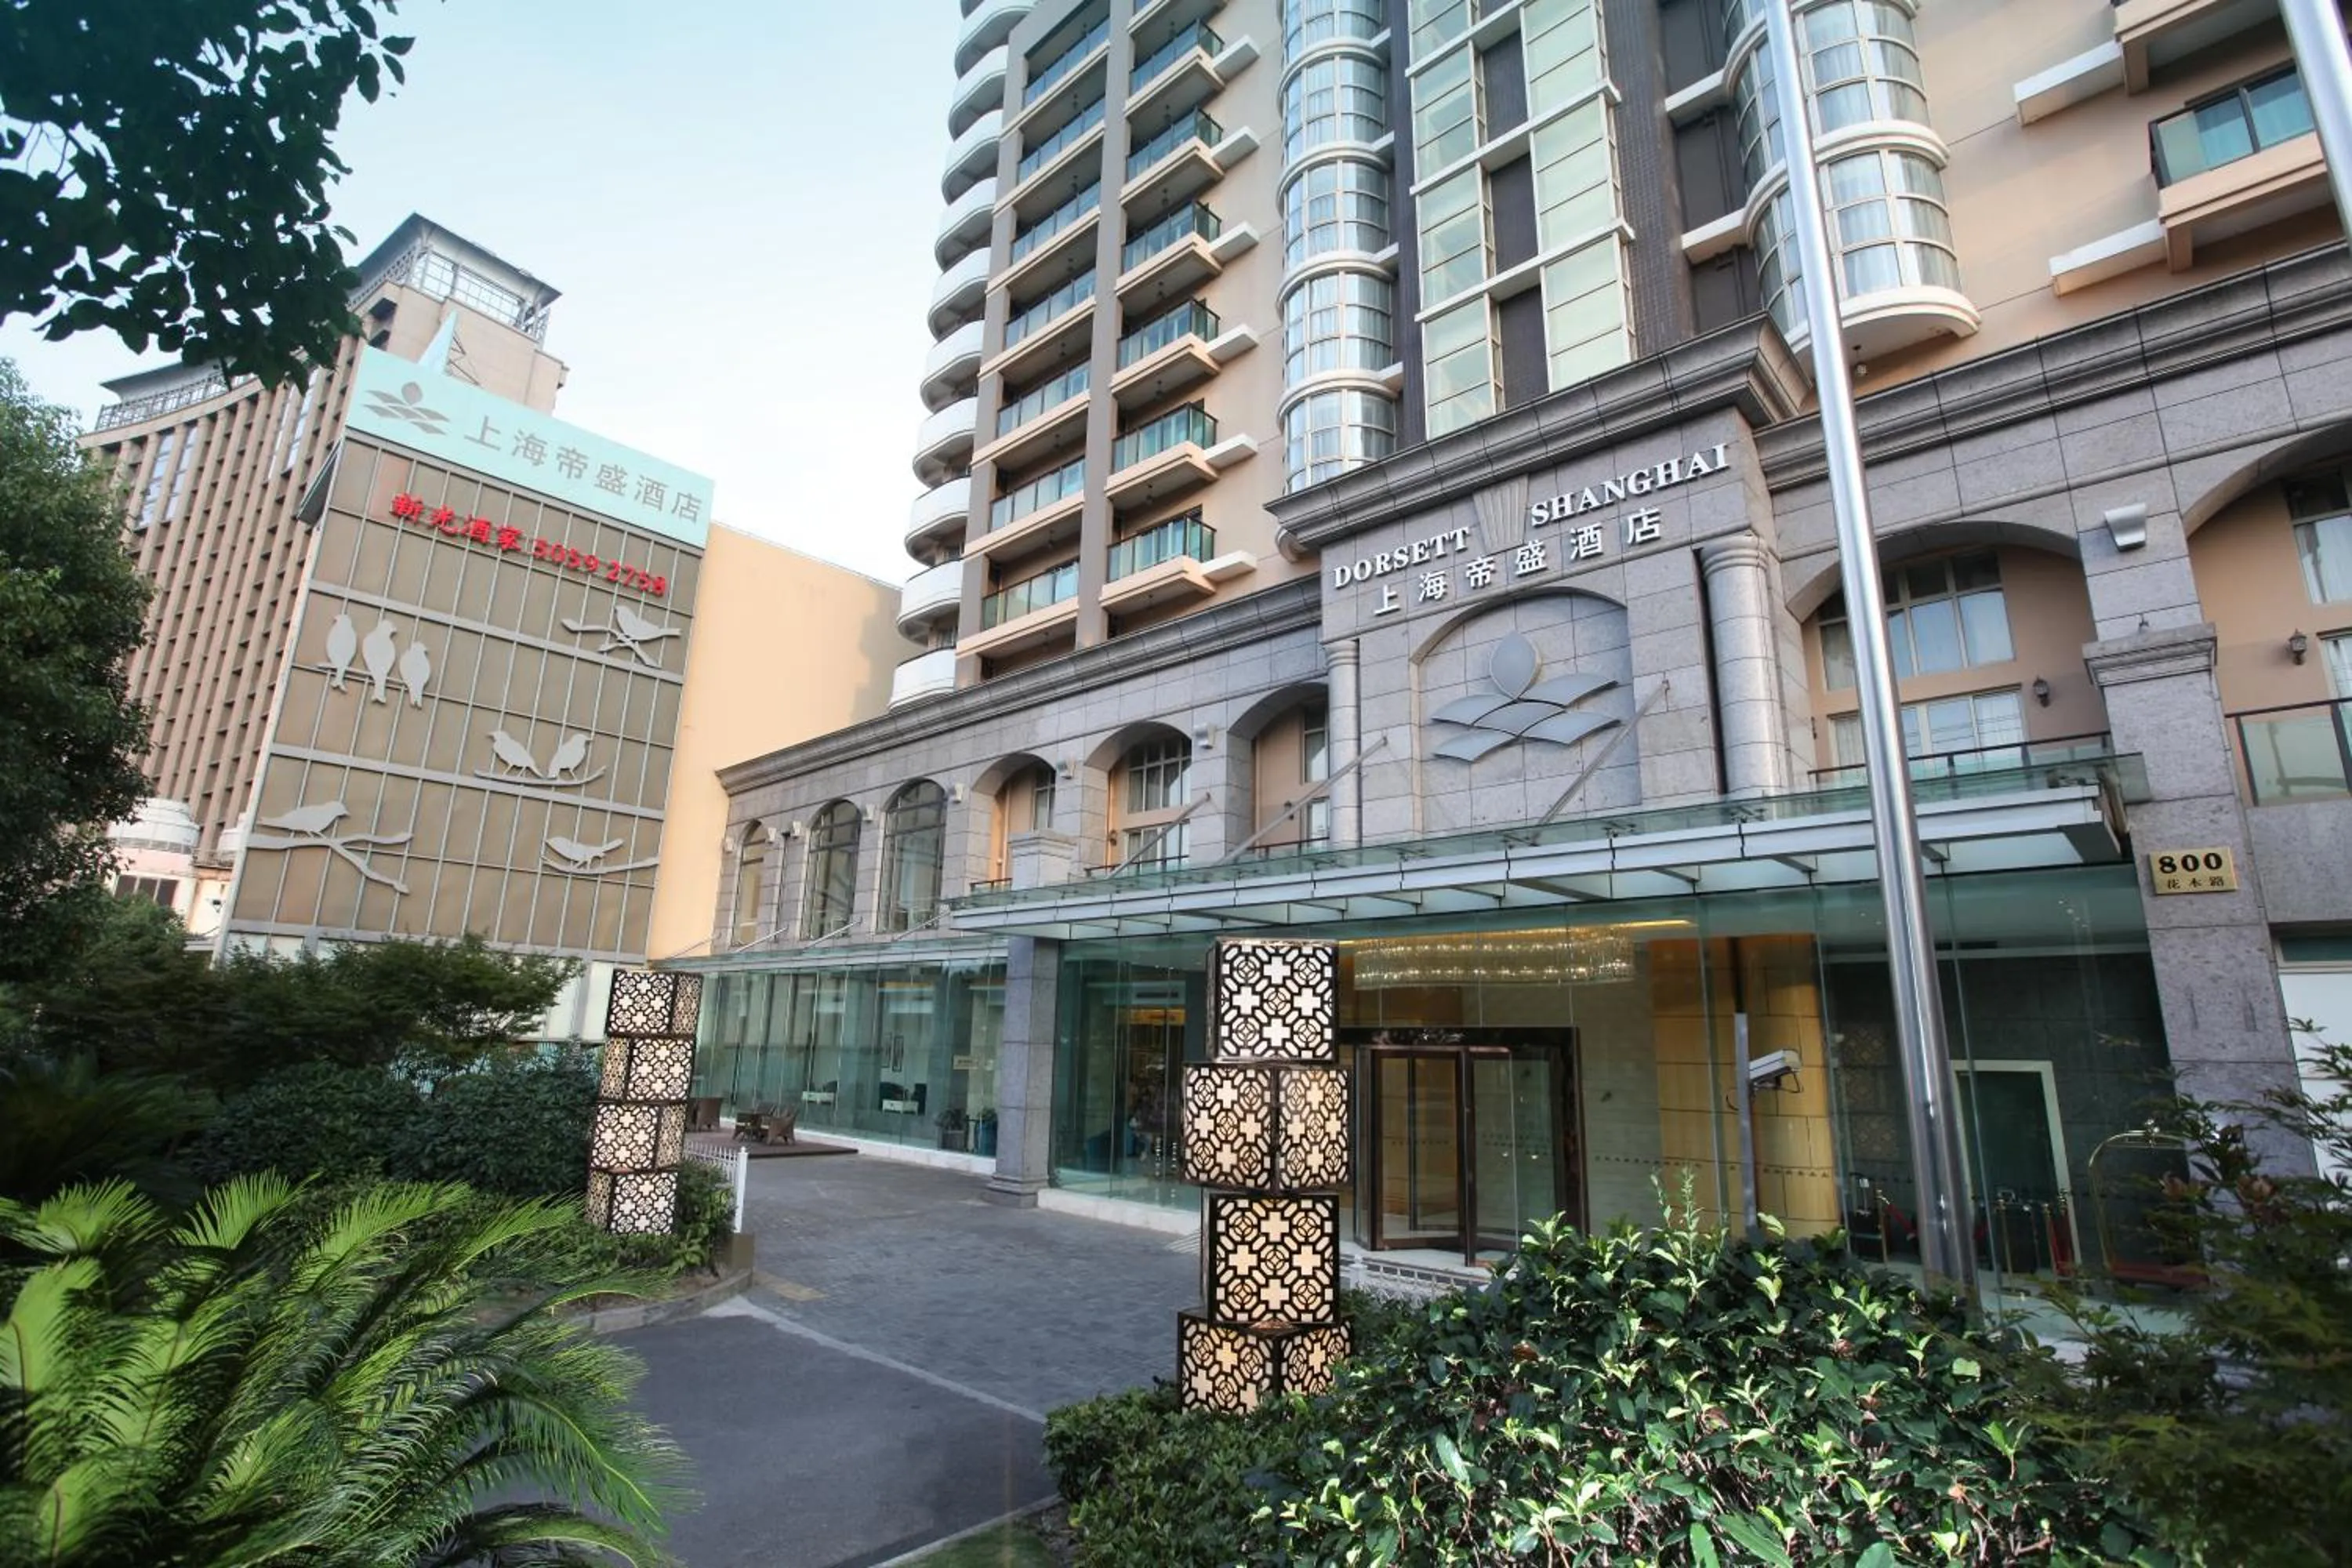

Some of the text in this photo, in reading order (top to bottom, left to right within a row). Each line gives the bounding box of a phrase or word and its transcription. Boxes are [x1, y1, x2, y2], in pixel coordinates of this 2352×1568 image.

[464, 416, 702, 523] 上海帝盛酒店
[1334, 443, 1732, 590] DORSETT SHANGHAI
[1374, 507, 1661, 616] 上海帝盛酒店
[2158, 852, 2223, 874] 800
